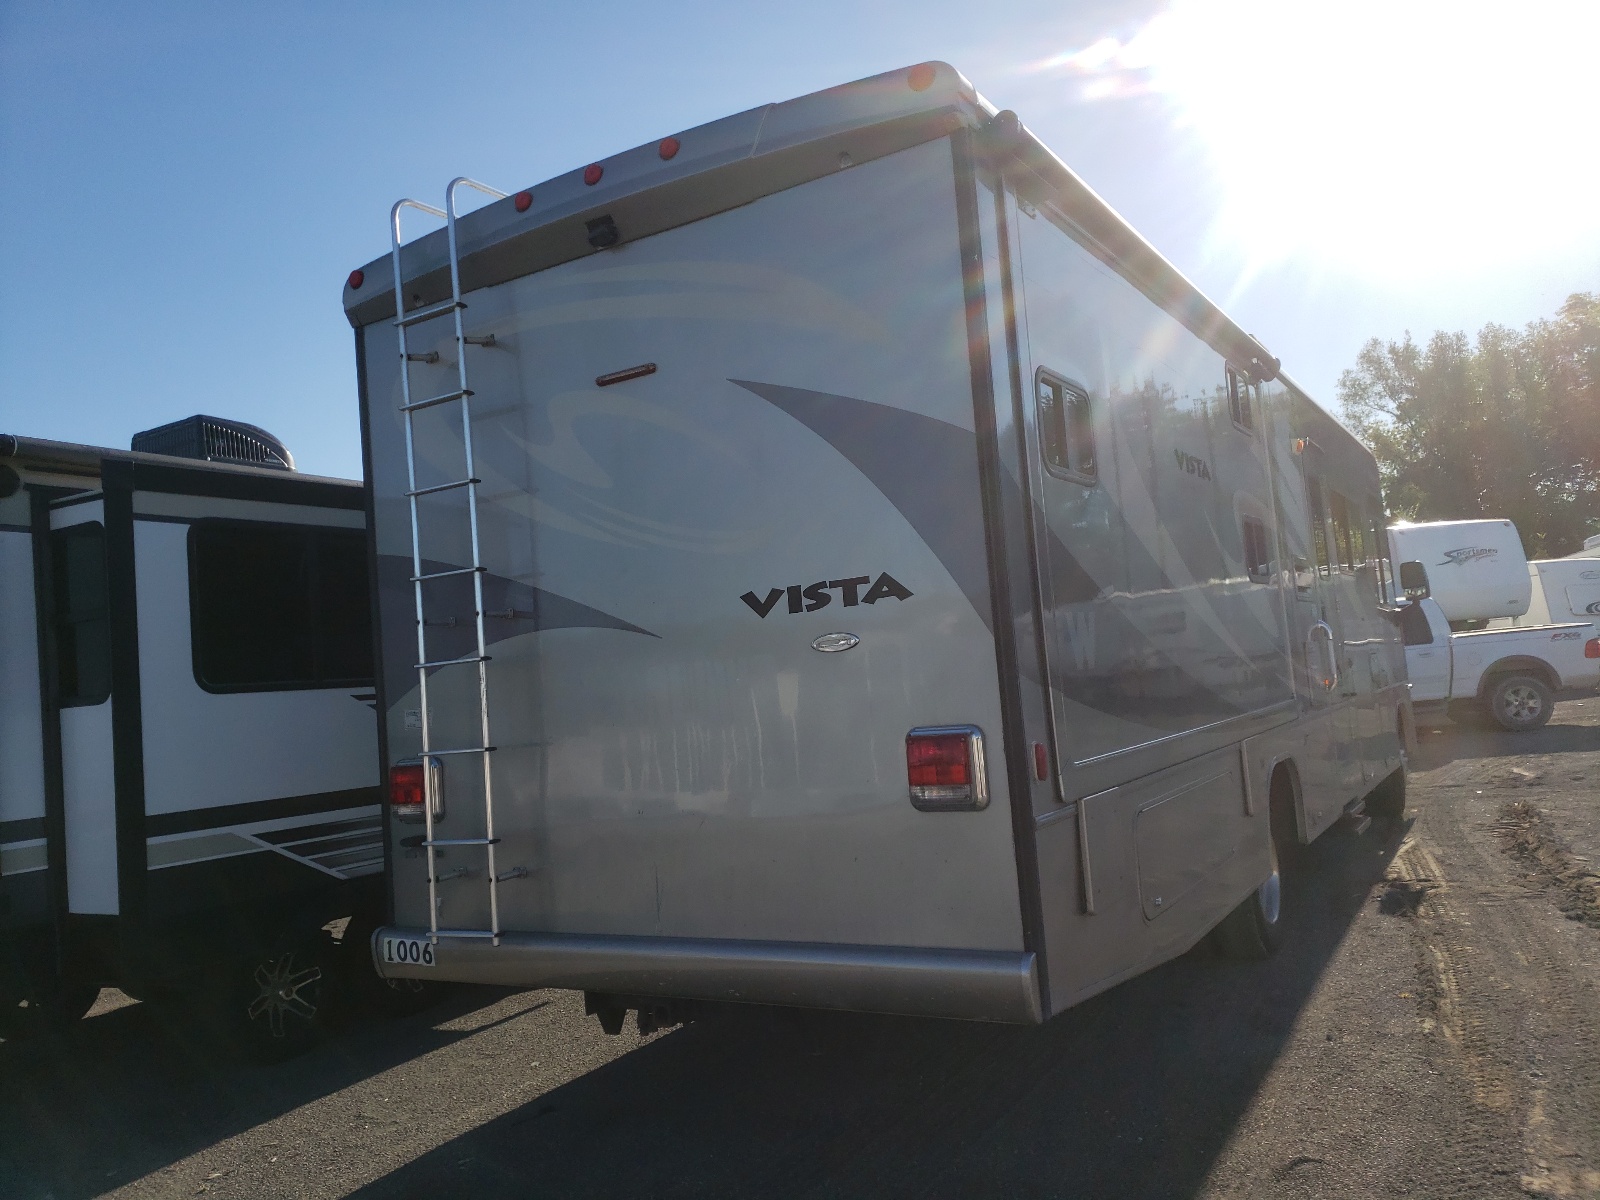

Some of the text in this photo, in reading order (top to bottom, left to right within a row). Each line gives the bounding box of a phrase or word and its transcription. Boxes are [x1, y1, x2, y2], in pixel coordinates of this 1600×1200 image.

[1173, 448, 1211, 481] VISTA
[739, 571, 914, 619] VISTA
[386, 939, 433, 964] 1006
